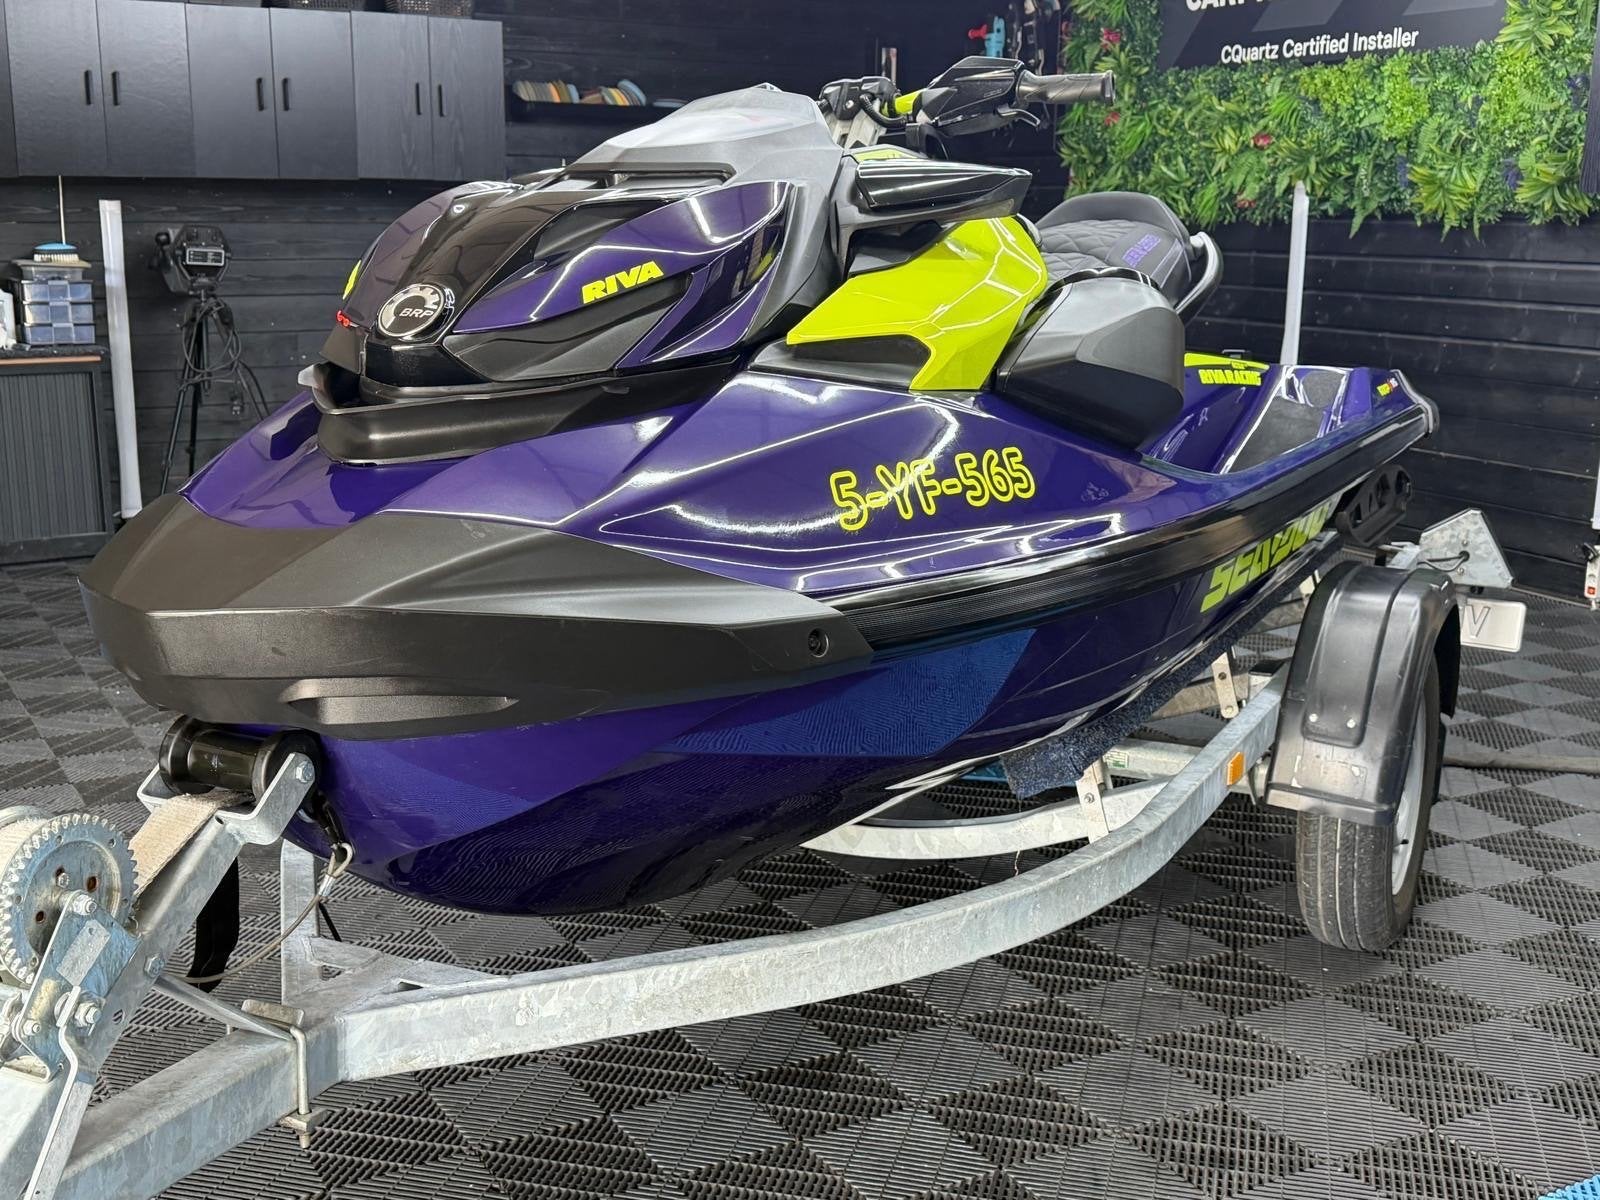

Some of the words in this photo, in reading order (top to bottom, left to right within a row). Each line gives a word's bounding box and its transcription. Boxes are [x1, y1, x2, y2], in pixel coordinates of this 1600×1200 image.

[1221, 42, 1280, 64] CQuartz
[1282, 32, 1350, 58] Certified
[1353, 27, 1419, 52] Installer
[581, 260, 665, 304] RIVA
[399, 307, 434, 319] BRP
